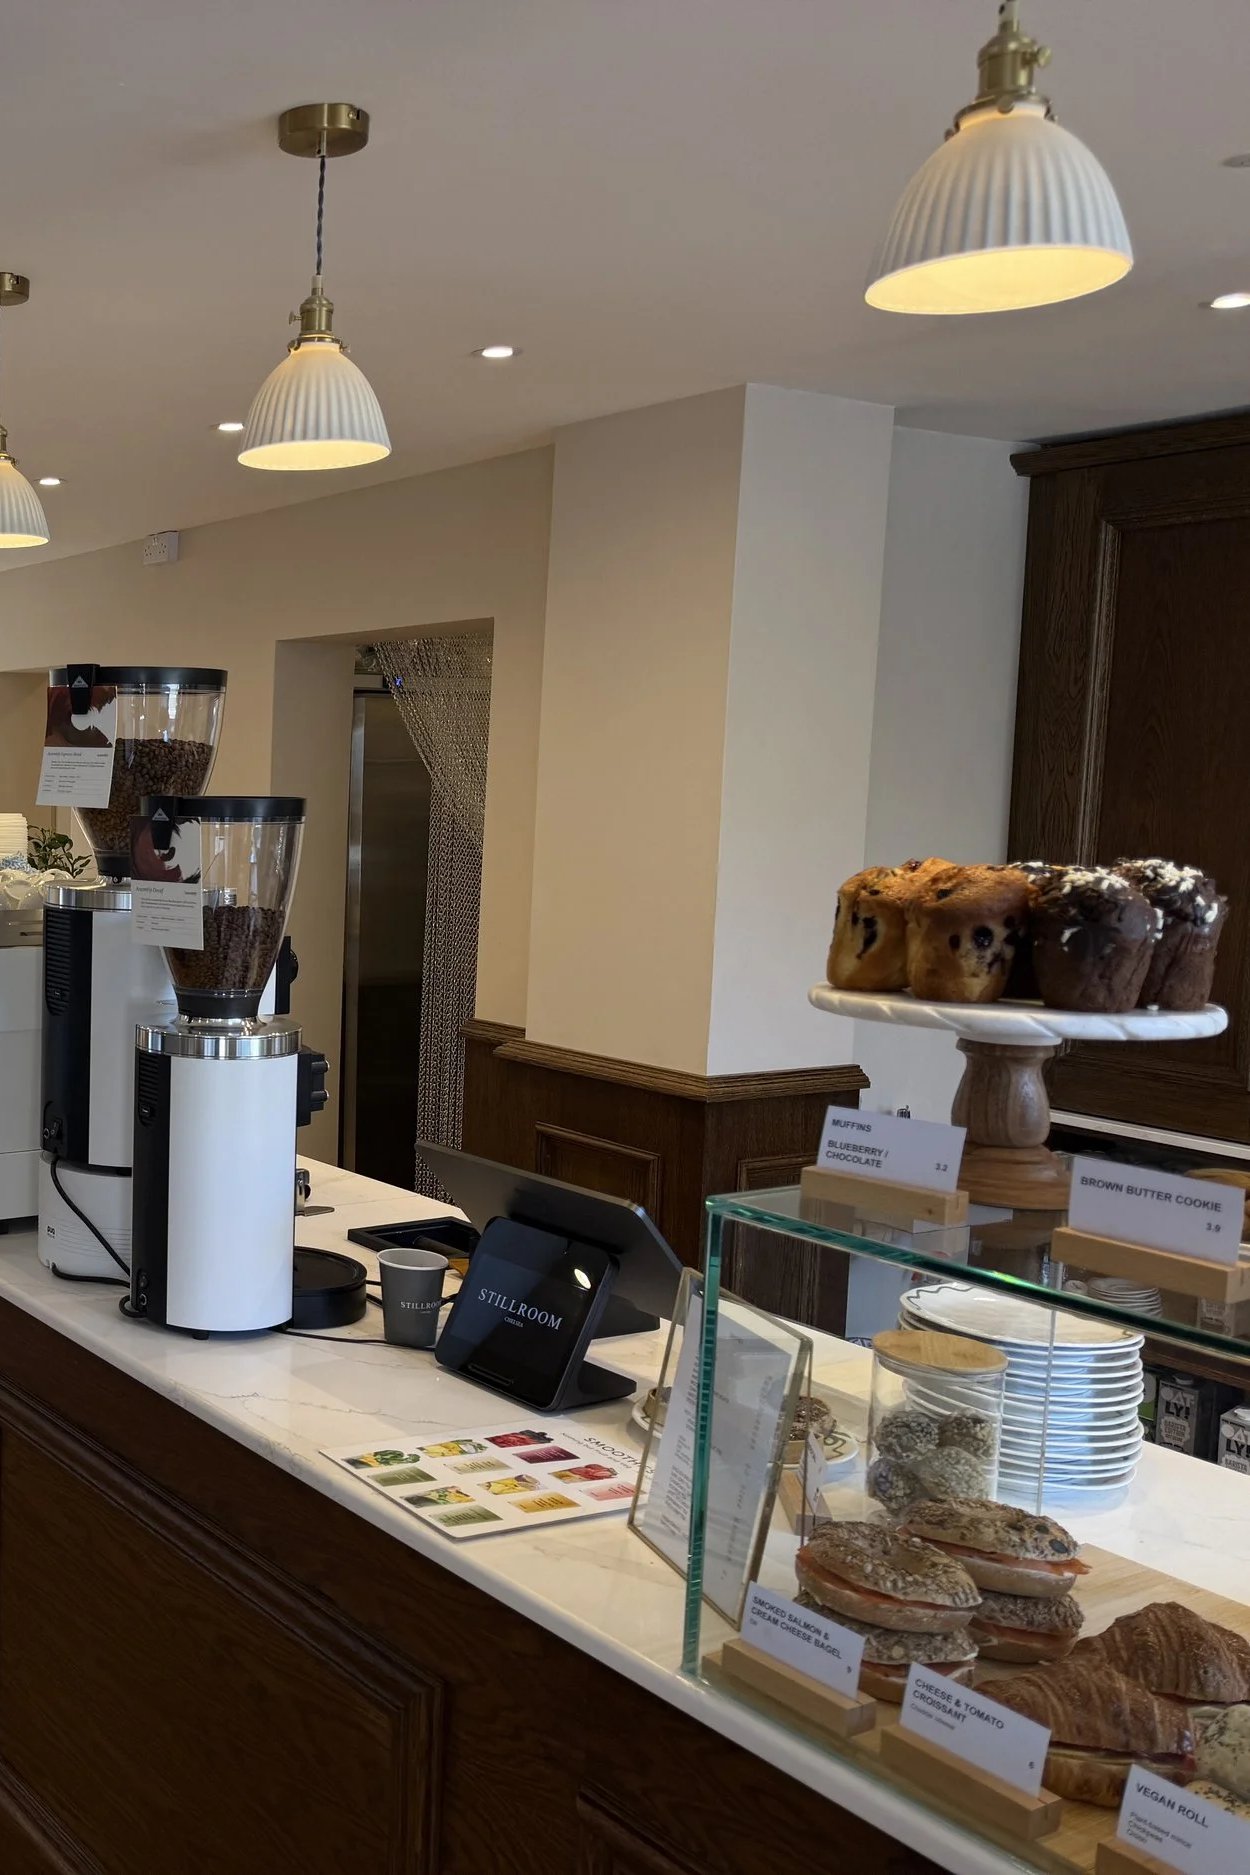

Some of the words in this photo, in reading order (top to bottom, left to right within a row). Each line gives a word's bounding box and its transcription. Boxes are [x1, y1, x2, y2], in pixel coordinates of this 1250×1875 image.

[832, 1119, 872, 1133] MUFFINS
[825, 1151, 883, 1169] CHOCOLATE
[828, 1140, 885, 1158] BLUEBERRY
[935, 1163, 948, 1172] 3.2
[1080, 1176, 1123, 1193] BROWN
[1126, 1185, 1172, 1203] BUTTER
[1175, 1195, 1222, 1212] COOKIE
[478, 1288, 564, 1331] STILLROOM
[504, 1316, 524, 1328] CHELSEA
[751, 1606, 779, 1626] CREAM
[780, 1621, 812, 1643] CHEESE
[814, 1638, 842, 1660] BAGEL
[752, 1596, 786, 1618] SMOKED
[788, 1614, 822, 1637] SALMON
[823, 1632, 830, 1640] &
[912, 1690, 967, 1723] CROISSANT
[915, 1678, 953, 1704] CHEESE
[954, 1698, 962, 1708] &
[964, 1702, 1005, 1730] TOMATO
[1136, 1783, 1176, 1811] VEGAN
[1177, 1804, 1209, 1829] ROLL
